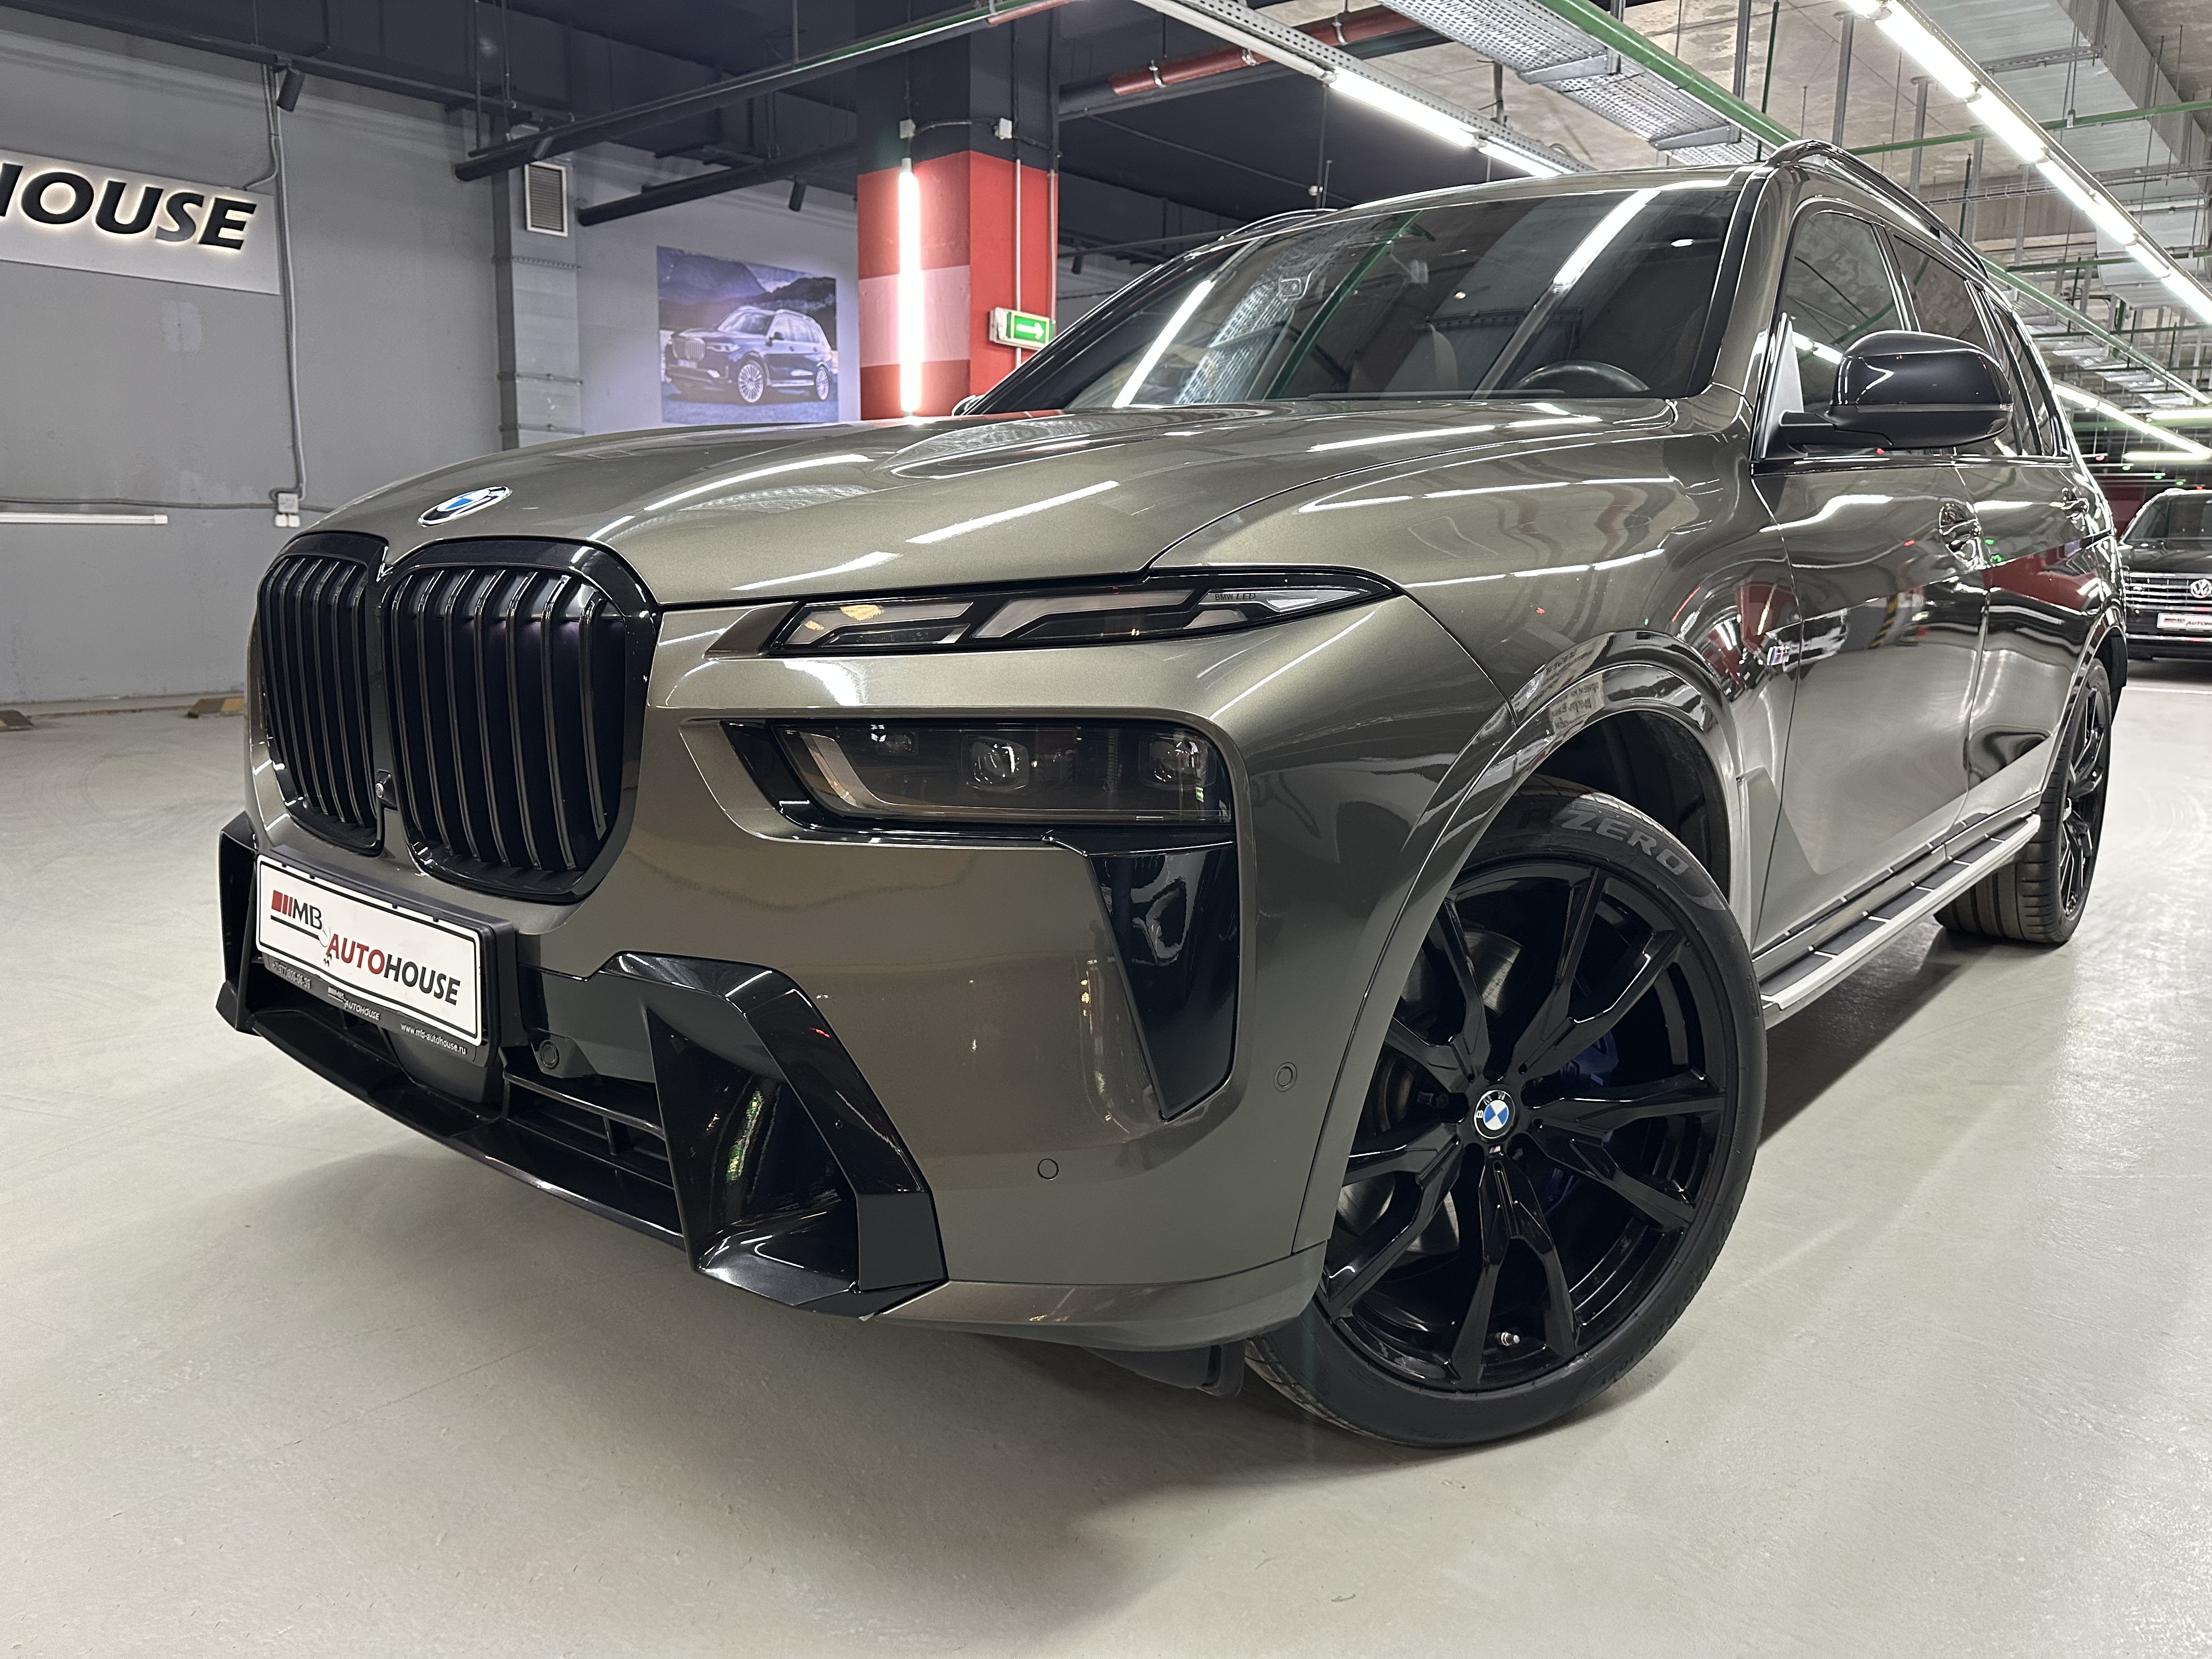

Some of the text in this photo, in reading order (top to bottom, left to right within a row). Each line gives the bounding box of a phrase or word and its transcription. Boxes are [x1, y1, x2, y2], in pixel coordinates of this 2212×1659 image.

[1561, 808, 1689, 876] ZERO
[326, 933, 461, 1006] AUTOHOUSE
[345, 1000, 380, 1020] AUTOHOUSE
[400, 1024, 466, 1054] www.mb-autohouse.ru
[1476, 1091, 1506, 1119] BMW
